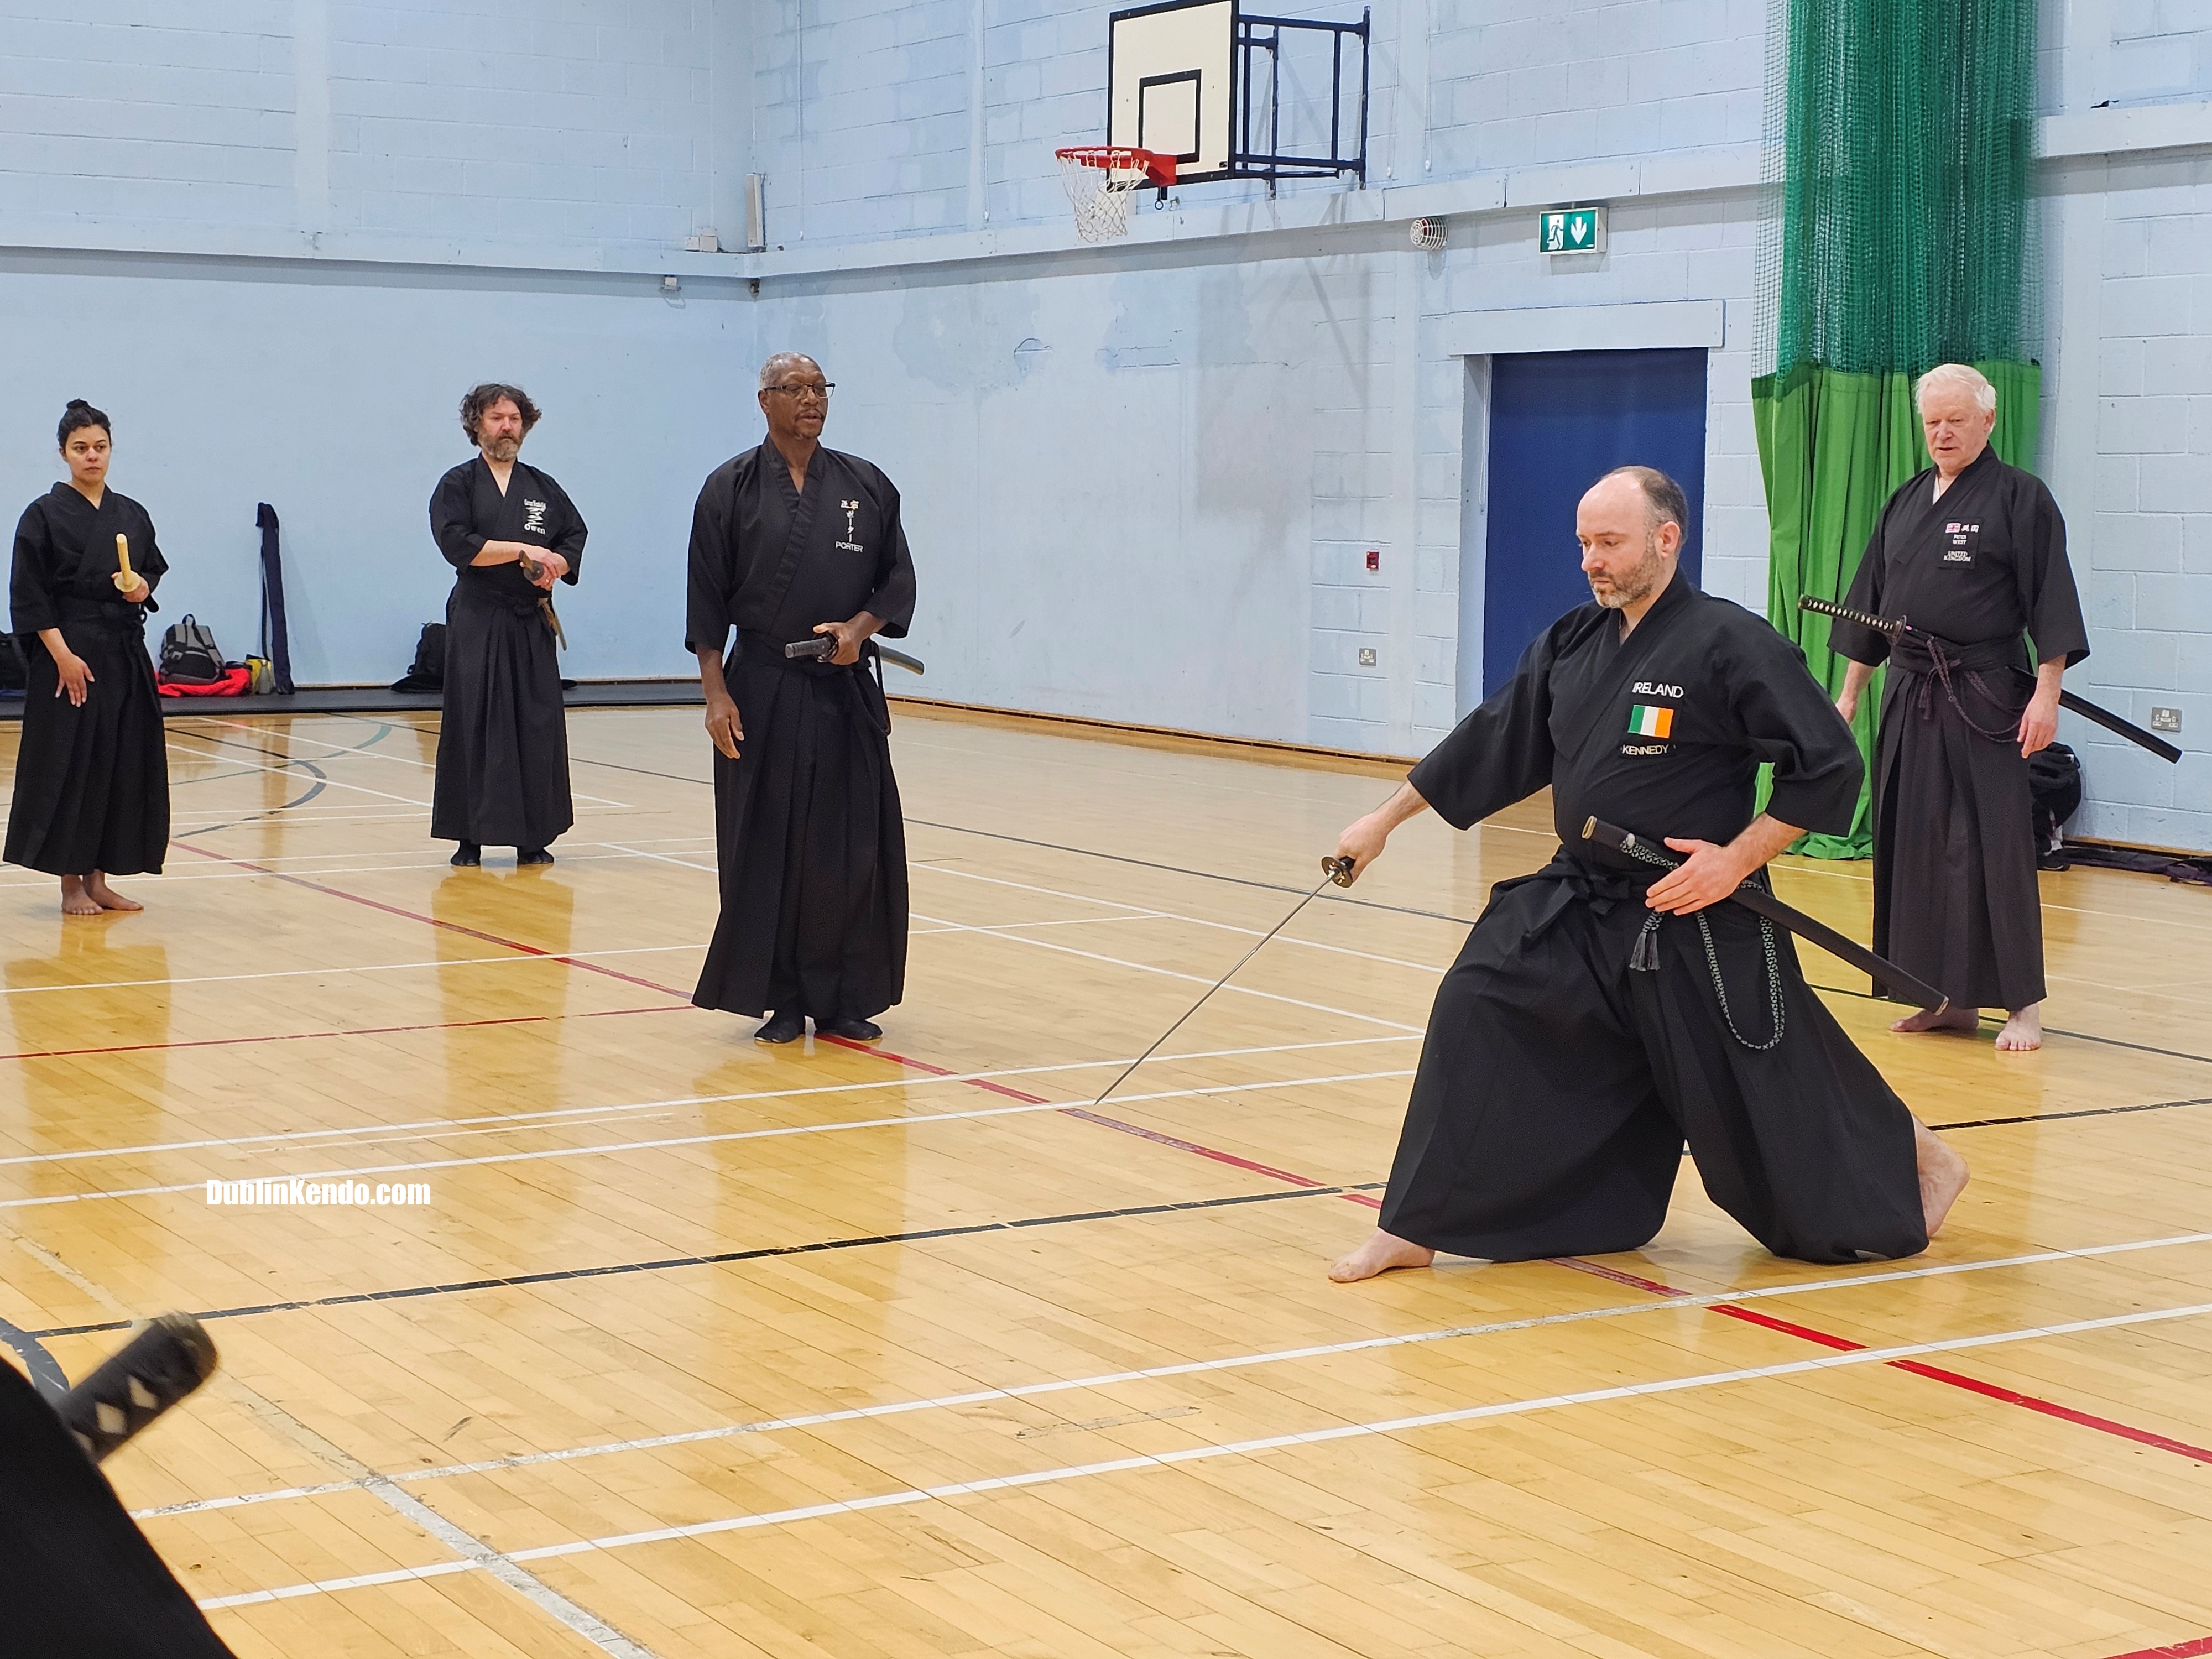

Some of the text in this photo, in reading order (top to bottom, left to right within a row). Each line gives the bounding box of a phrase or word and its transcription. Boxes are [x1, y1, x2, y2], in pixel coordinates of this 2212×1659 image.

[836, 541, 863, 553] PORTER
[1632, 682, 1684, 698] IRELAND
[1621, 744, 1669, 755] KENNEDY
